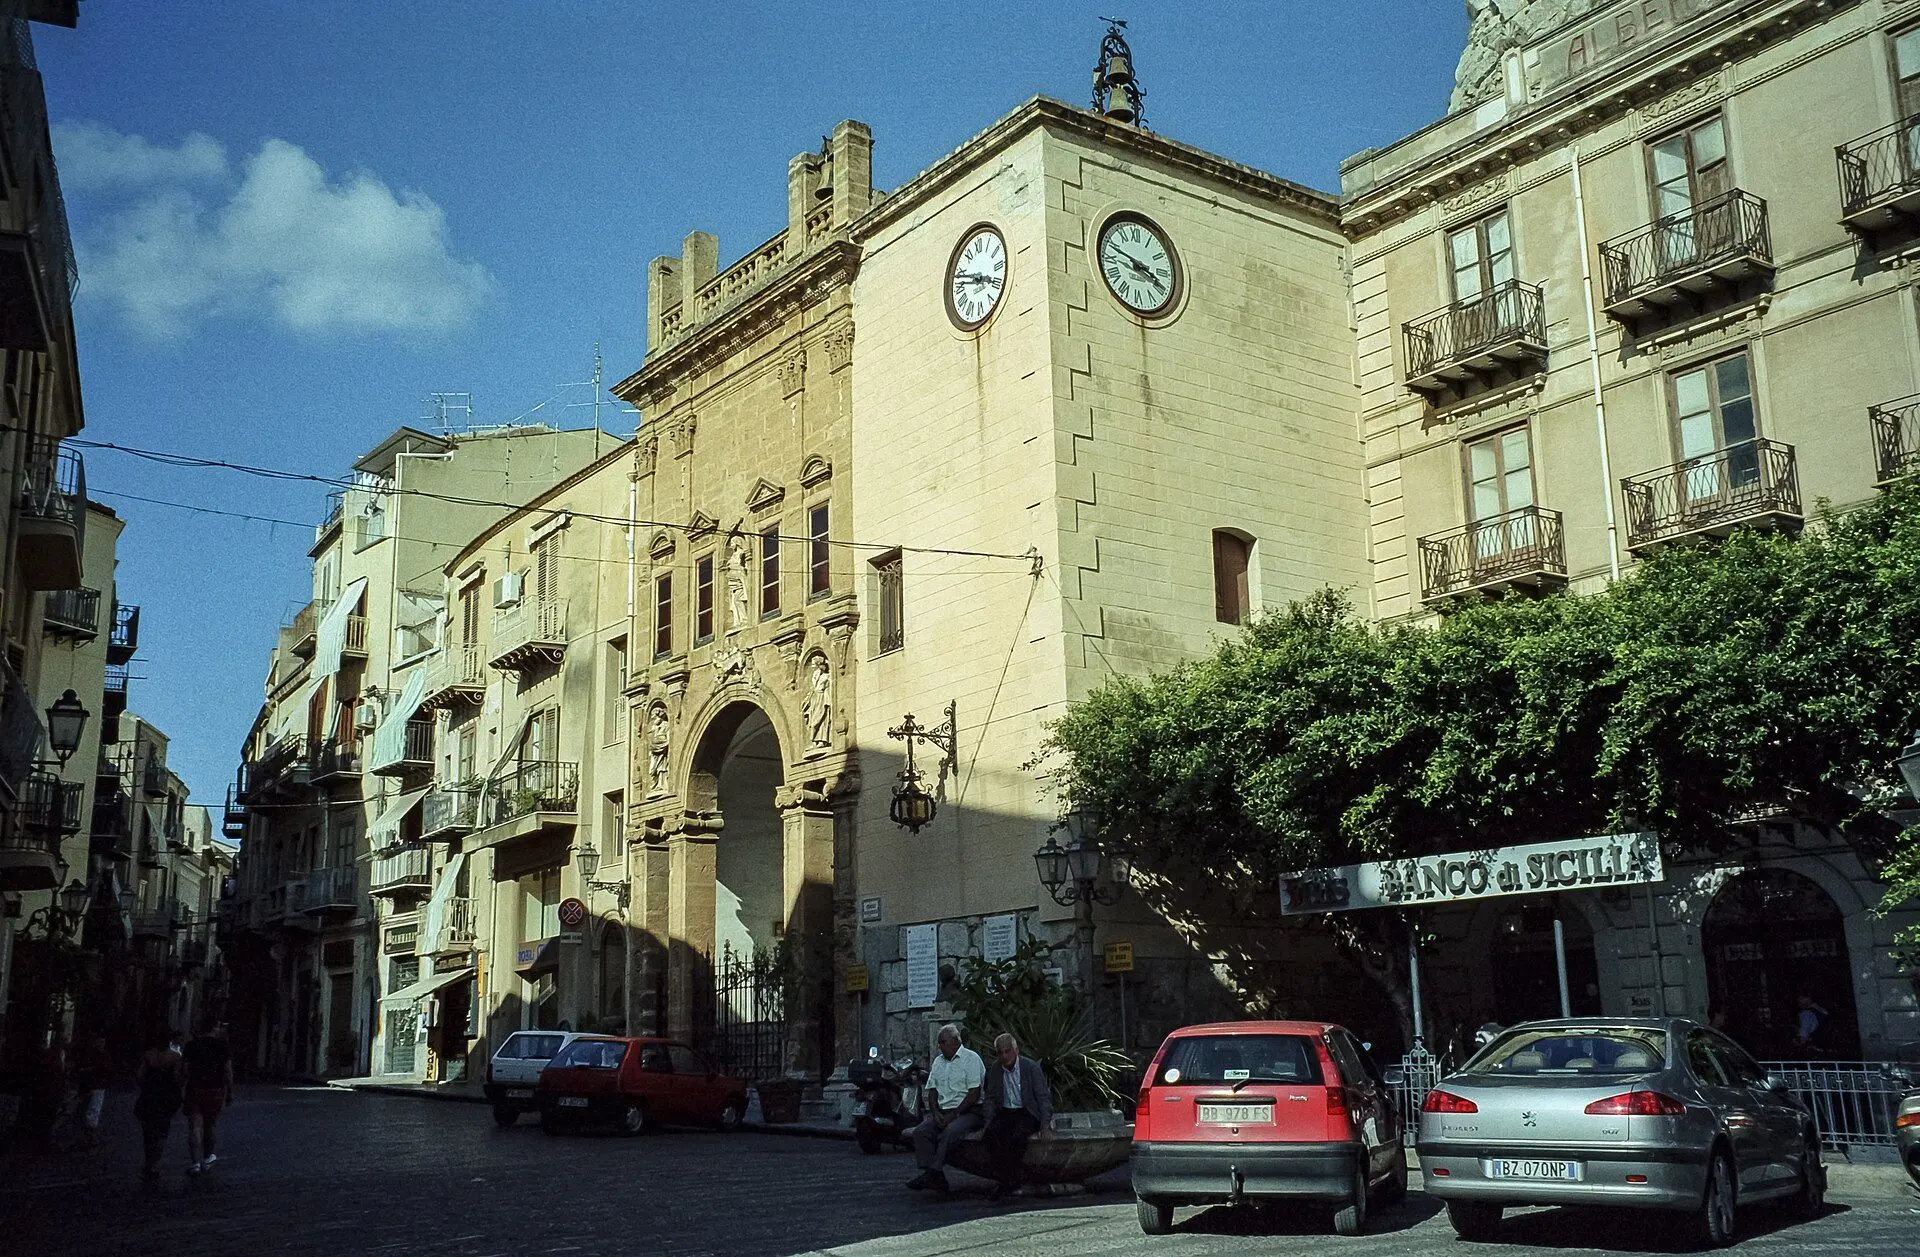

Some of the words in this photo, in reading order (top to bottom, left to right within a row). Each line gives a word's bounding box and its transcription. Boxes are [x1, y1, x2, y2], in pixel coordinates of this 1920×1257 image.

[1117, 227, 1129, 243] XI
[1130, 227, 1141, 243] XII
[1145, 235, 1153, 248] I
[1152, 252, 1164, 261] II
[1156, 268, 1168, 278] III
[1382, 859, 1488, 902] BANCO
[1496, 862, 1522, 891] di
[1526, 838, 1645, 888] SICILIA
[427, 1046, 435, 1079] odak
[1202, 1107, 1218, 1121] BB
[1225, 1107, 1249, 1120] 978
[1253, 1106, 1270, 1120] FS
[1502, 1161, 1519, 1176] BZ
[1523, 1162, 1567, 1177] 070NP
